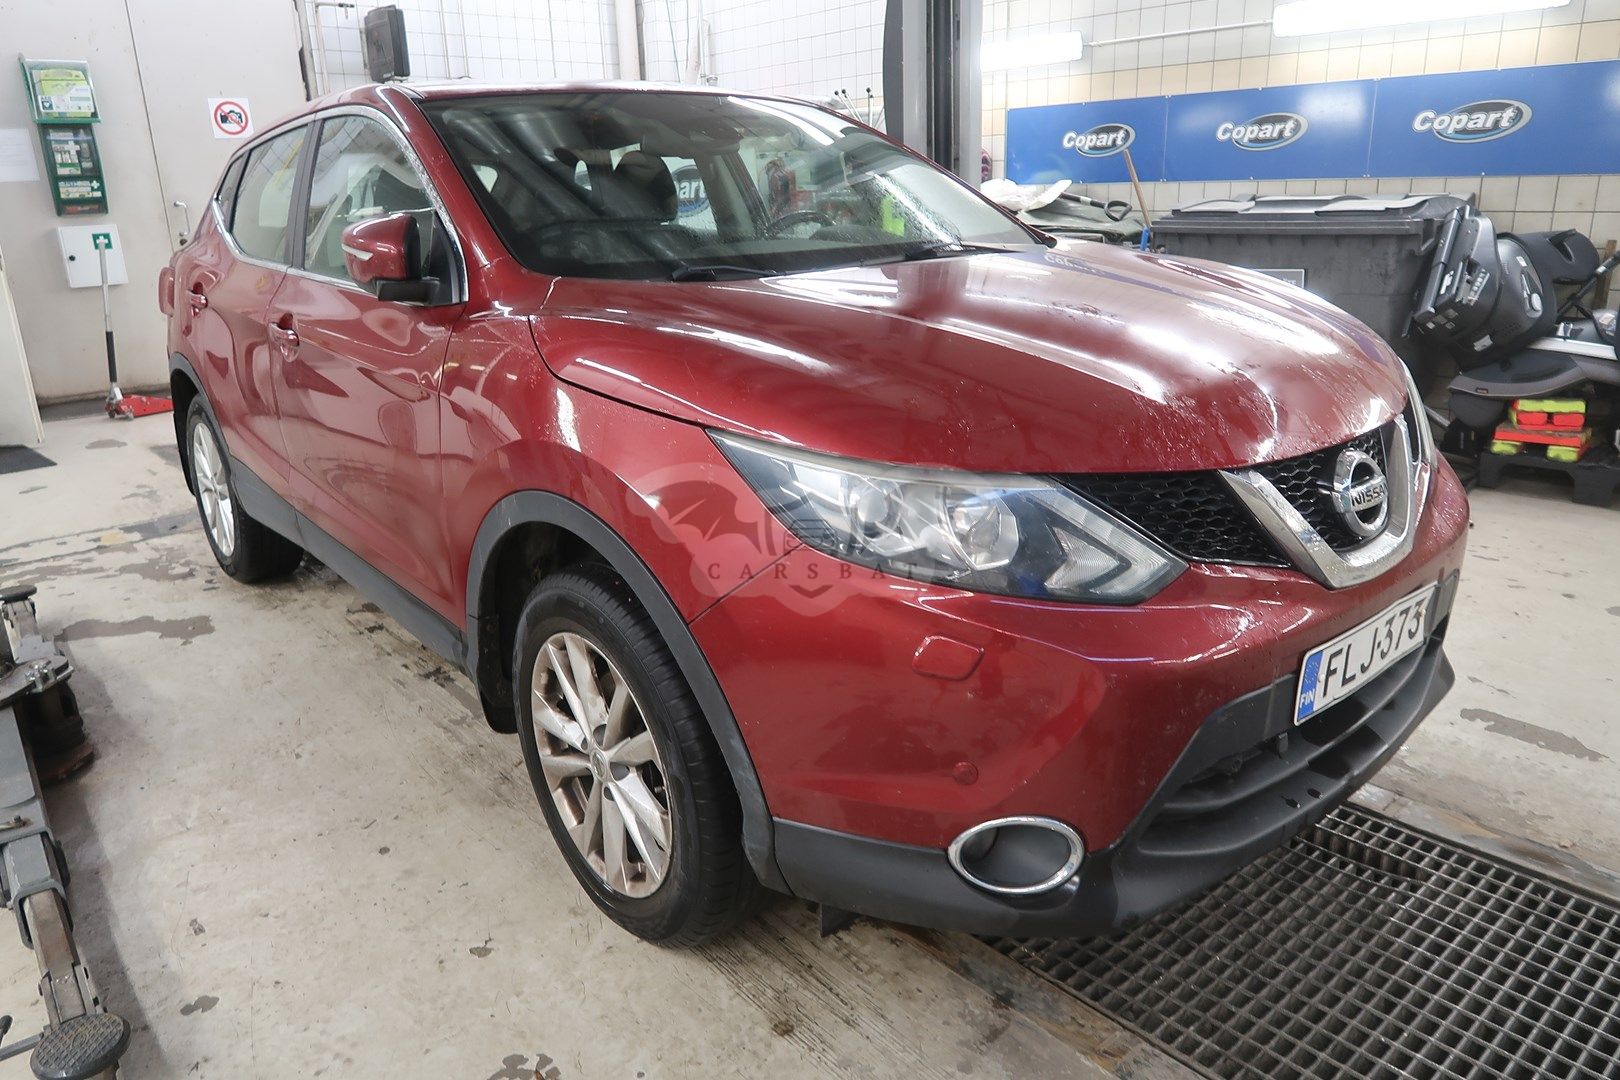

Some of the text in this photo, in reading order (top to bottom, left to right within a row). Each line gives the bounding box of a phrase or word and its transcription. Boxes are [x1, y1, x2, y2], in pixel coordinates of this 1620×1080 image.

[1218, 119, 1296, 141] Copart
[1414, 109, 1516, 133] Copart
[1064, 129, 1125, 149] Copart
[674, 179, 706, 199] art
[1323, 597, 1426, 697] FLJ-373
[1299, 689, 1315, 708] FIN
